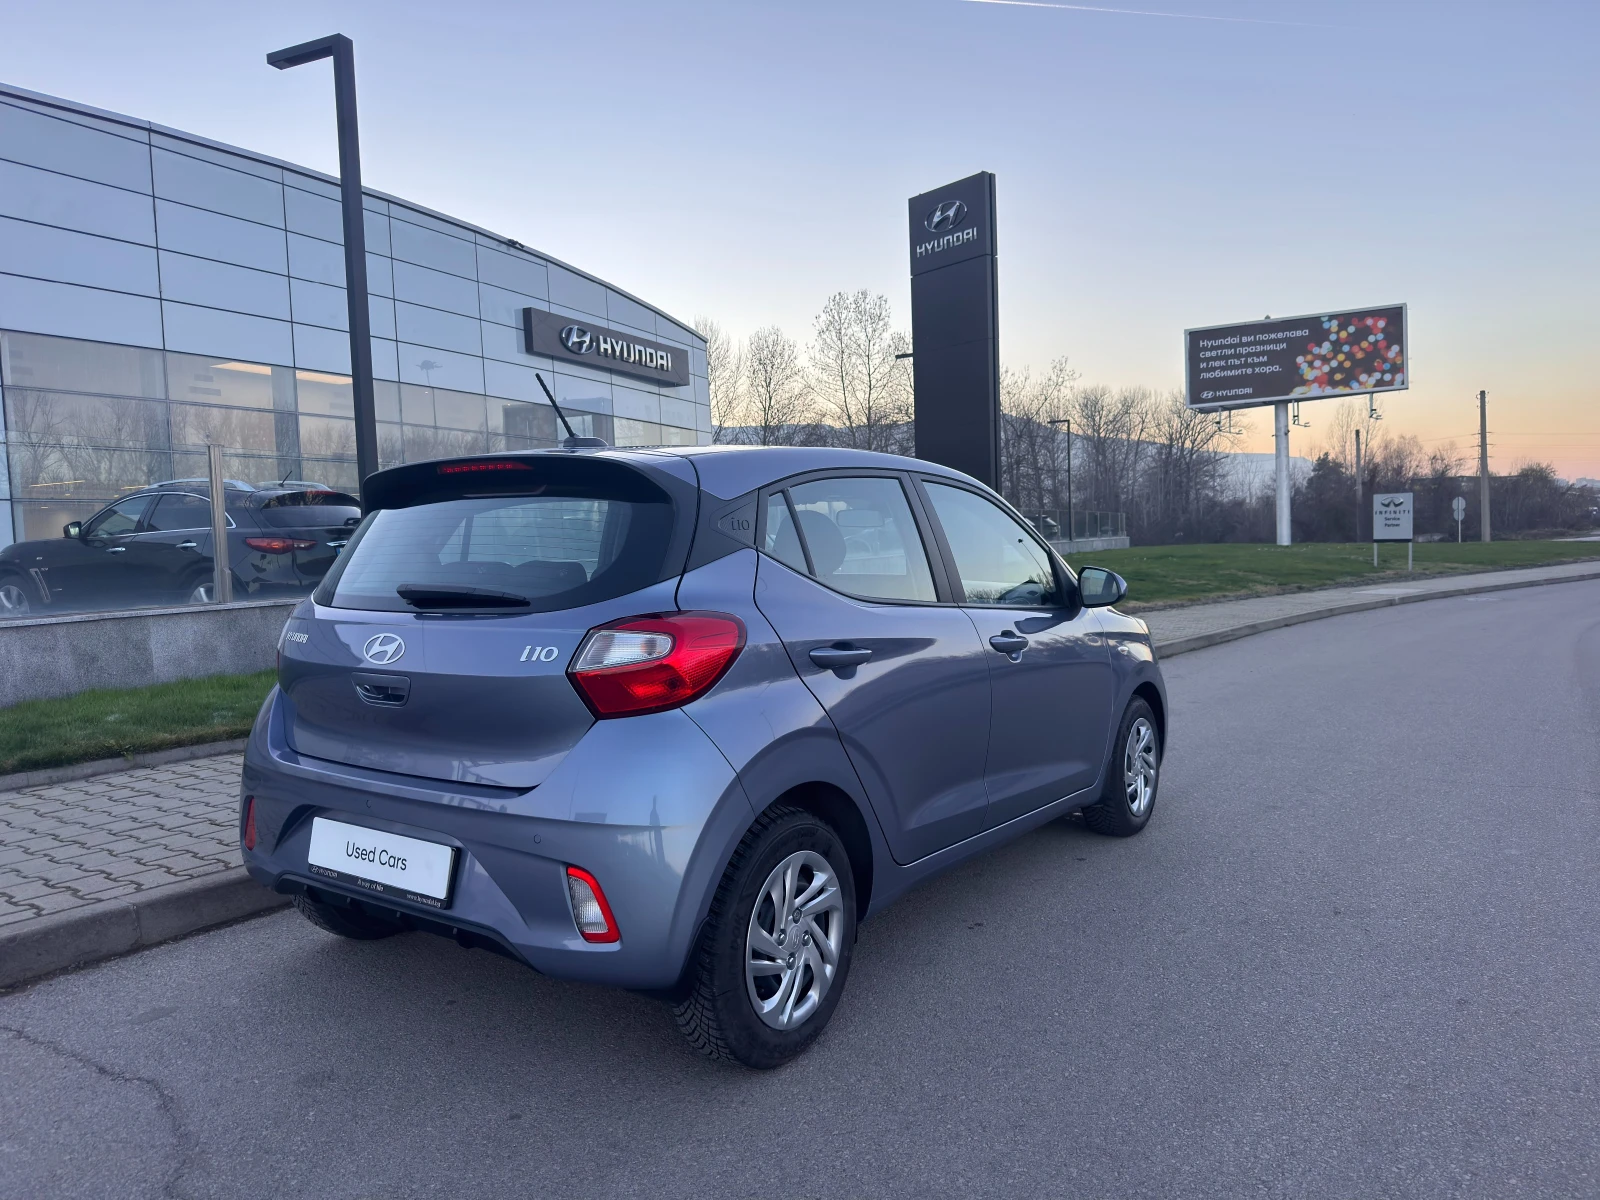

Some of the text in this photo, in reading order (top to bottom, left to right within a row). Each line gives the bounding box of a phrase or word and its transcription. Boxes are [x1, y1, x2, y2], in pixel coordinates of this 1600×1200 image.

[916, 226, 977, 258] HYUNDAI
[1199, 335, 1240, 348] Hyundai
[1256, 329, 1309, 341] пожелава
[599, 335, 672, 372] HYUNDAI
[1199, 342, 1287, 358] светли празници
[1208, 360, 1226, 368] лек
[1228, 357, 1245, 366] път
[1247, 355, 1268, 363] към
[1200, 365, 1282, 379] любимите хора.
[1216, 387, 1253, 397] HYUNDAI
[346, 840, 407, 871] Used Cars
